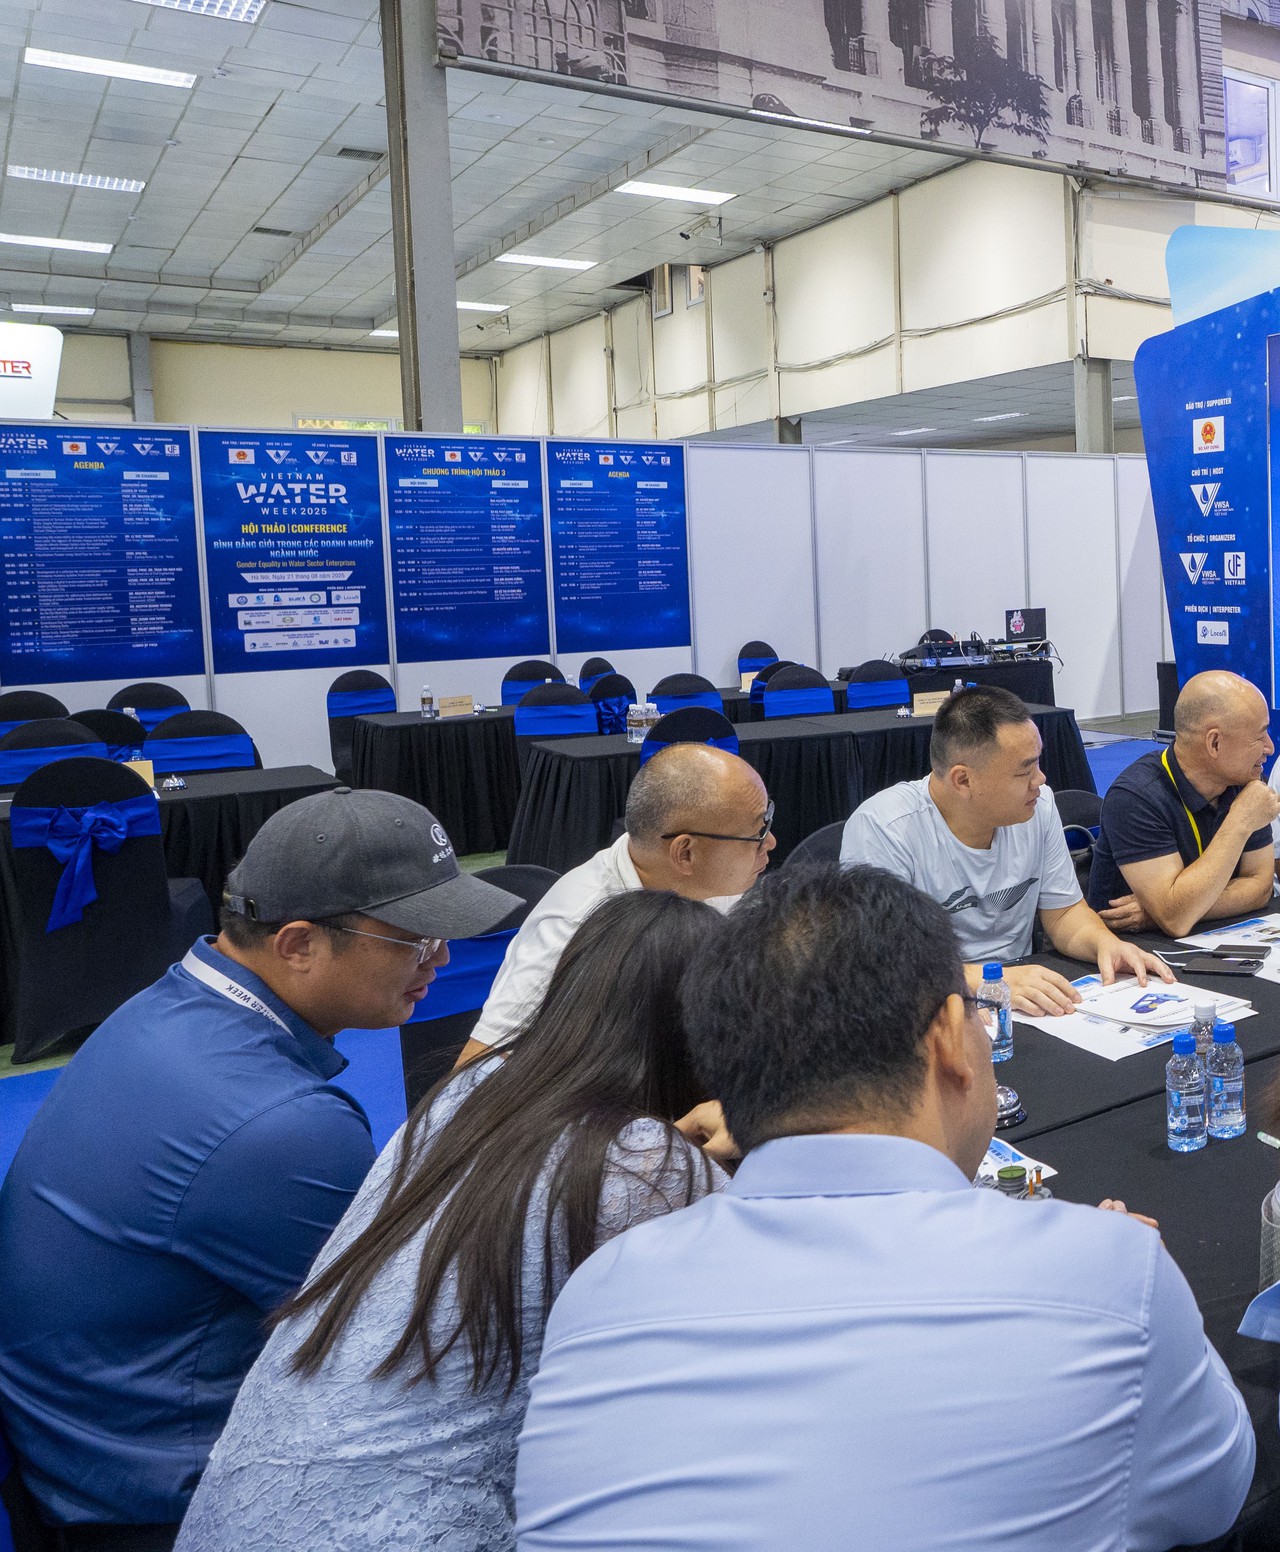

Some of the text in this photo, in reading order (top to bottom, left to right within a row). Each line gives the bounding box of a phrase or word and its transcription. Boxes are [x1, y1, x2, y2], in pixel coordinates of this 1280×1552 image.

[0, 359, 32, 375] TER
[1206, 397, 1232, 408] SUPPORTER
[395, 448, 435, 458] WATER
[555, 452, 591, 461] WATER
[74, 461, 105, 470] AGENDA
[1212, 466, 1224, 475] HOST
[260, 472, 324, 481] VIETNAM
[422, 467, 450, 476] CHƯƠNG
[483, 467, 501, 477] THẢO
[236, 482, 349, 504] WATER
[241, 521, 348, 534] HỘI THẢO CONFERENCE
[1209, 534, 1236, 542] ORGANIZERS
[213, 539, 235, 549] BÌNH
[276, 540, 302, 549] TRONG
[303, 538, 319, 548] CÁC
[320, 540, 346, 548] DOANH
[347, 538, 374, 549] NGHIỆP
[270, 547, 319, 558] NGÀNH NƯỚC
[236, 560, 257, 569] Gender
[258, 559, 281, 569] Equality
[288, 560, 306, 568] Water
[307, 560, 325, 568] Sector
[326, 559, 357, 568] Enterprises
[271, 573, 286, 582] Ngày
[226, 984, 252, 1004] WEEK
